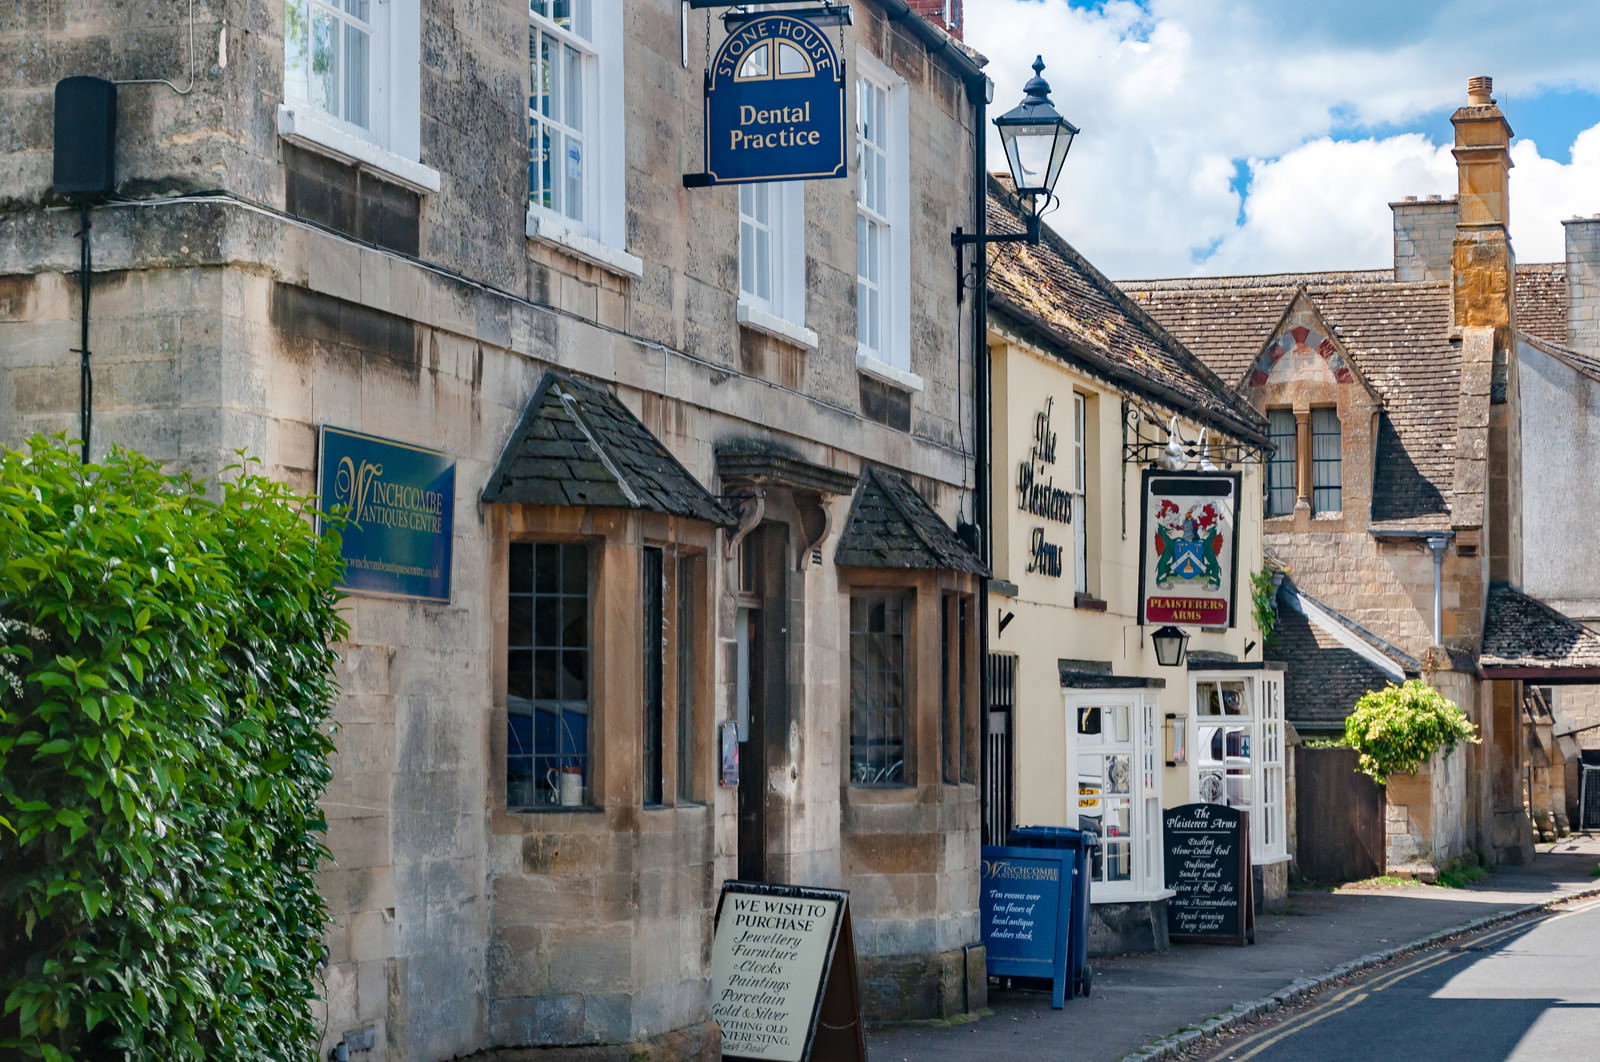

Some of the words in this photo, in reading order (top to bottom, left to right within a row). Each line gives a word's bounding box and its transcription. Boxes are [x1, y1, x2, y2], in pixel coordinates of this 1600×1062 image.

[719, 22, 769, 77] STONE
[778, 21, 831, 72] HOUSE
[740, 101, 810, 126] Dental
[730, 127, 821, 150] Practice
[1036, 395, 1057, 465] The
[335, 456, 443, 524] WINCHCOMBE
[1018, 447, 1072, 525] Plaisterers
[362, 506, 408, 529] ANTIQUES
[409, 514, 443, 534] CENTRE
[1028, 527, 1063, 578] Arms
[1150, 599, 1224, 610] PLAISTERERS
[1171, 611, 1202, 620] ARMS
[1194, 805, 1210, 819] The
[1166, 815, 1209, 829] Plaisterers
[1211, 819, 1237, 829] Arms
[1214, 845, 1232, 855] Food
[996, 872, 1031, 880] ANTIQUES
[1032, 873, 1057, 881] CENTRE
[990, 890, 1003, 899] Ten
[1004, 892, 1025, 900] rooms
[1193, 883, 1201, 895] of
[734, 899, 760, 912] WE
[765, 901, 803, 916] WISH
[806, 904, 827, 918] TO
[993, 903, 1005, 912] two
[1005, 902, 1025, 915] floors
[1025, 903, 1035, 915] of
[735, 914, 814, 932] PURCHASE
[992, 915, 1009, 925] local
[1008, 916, 1034, 930] antique
[734, 930, 802, 949] Jewellery
[990, 927, 1014, 939] dealers
[731, 944, 798, 961] Furniture
[733, 960, 783, 975] Clocks
[728, 974, 791, 992] Paintings
[721, 988, 786, 1006] Porcelain
[711, 1003, 742, 1017] Gold
[742, 1008, 750, 1018] &
[751, 1006, 789, 1021] Silver
[715, 1019, 762, 1032] NYTHING
[765, 1024, 788, 1034] OLD
[720, 1030, 790, 1046] NTERESTING.
